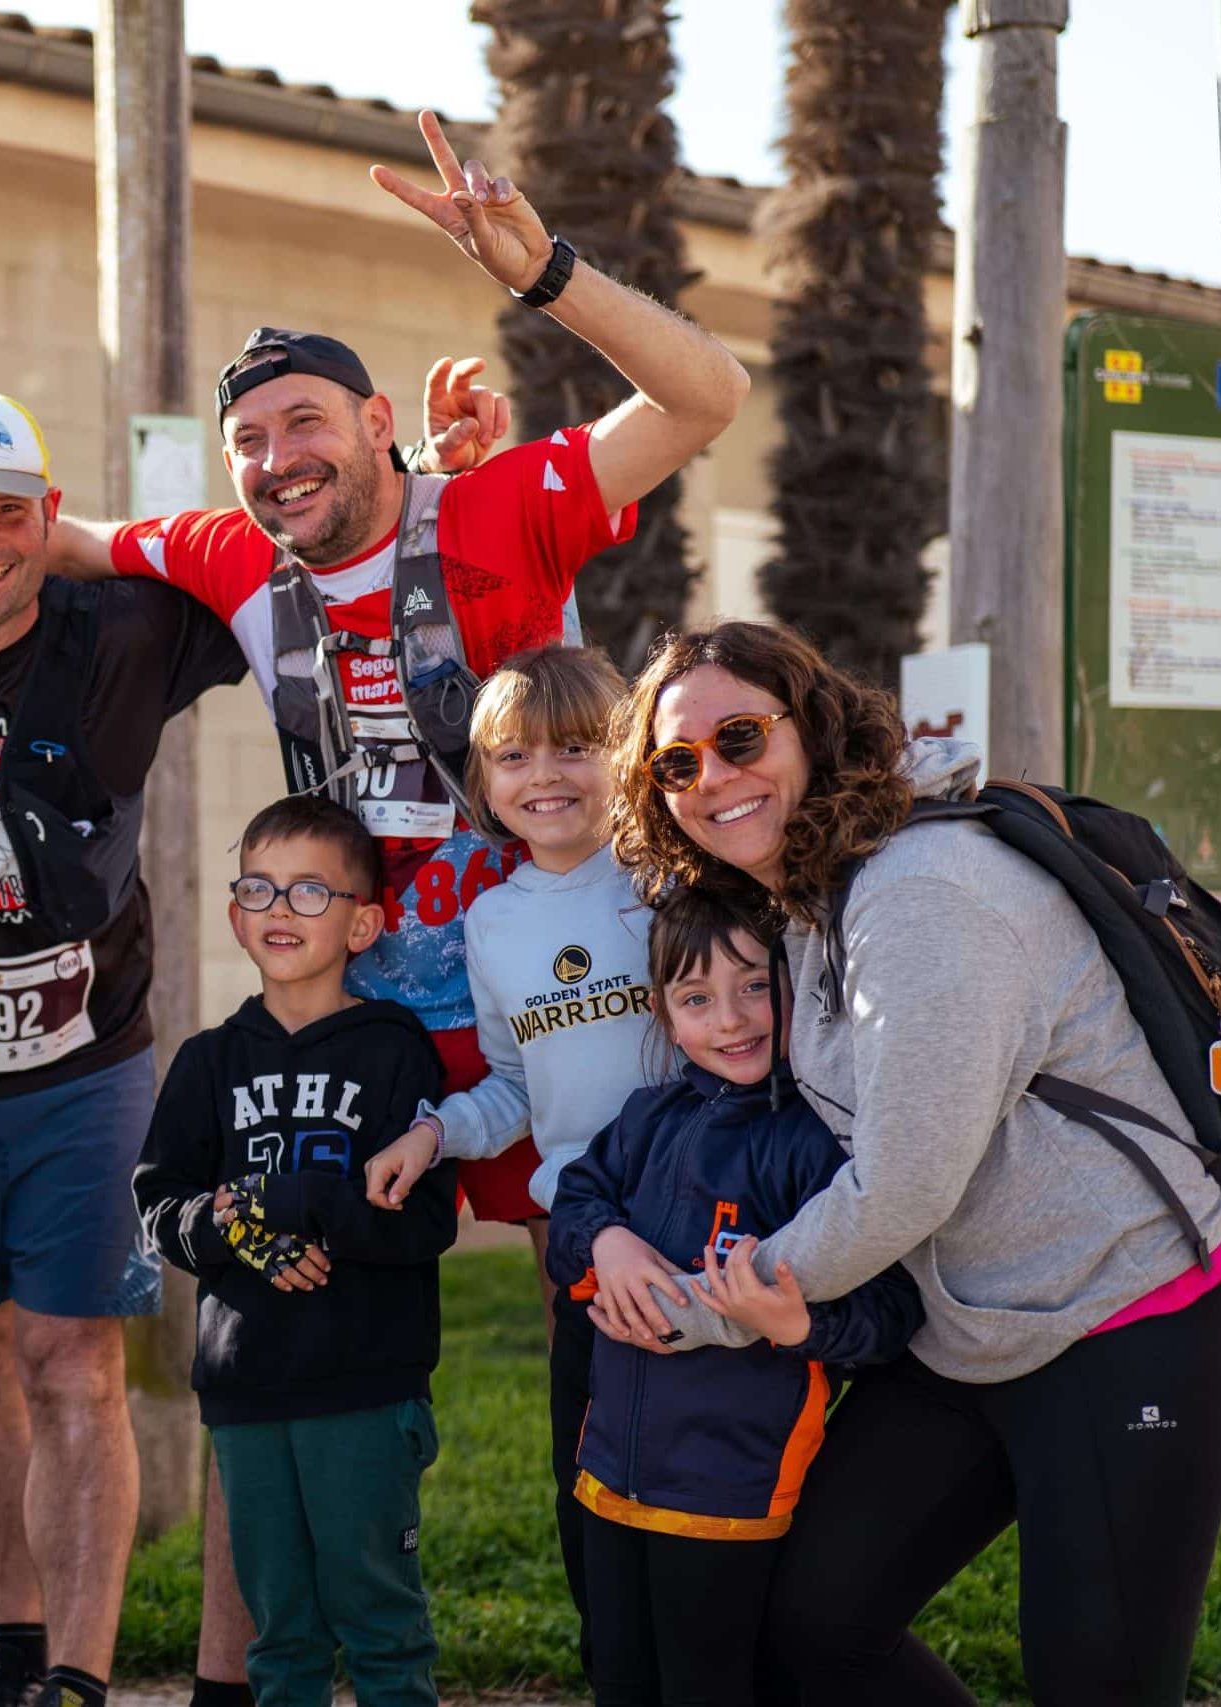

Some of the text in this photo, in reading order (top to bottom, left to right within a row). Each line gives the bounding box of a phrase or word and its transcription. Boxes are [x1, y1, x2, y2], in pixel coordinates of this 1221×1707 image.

[525, 974, 632, 1008] GOLDEN STATE
[232, 1074, 362, 1131] ATHL
